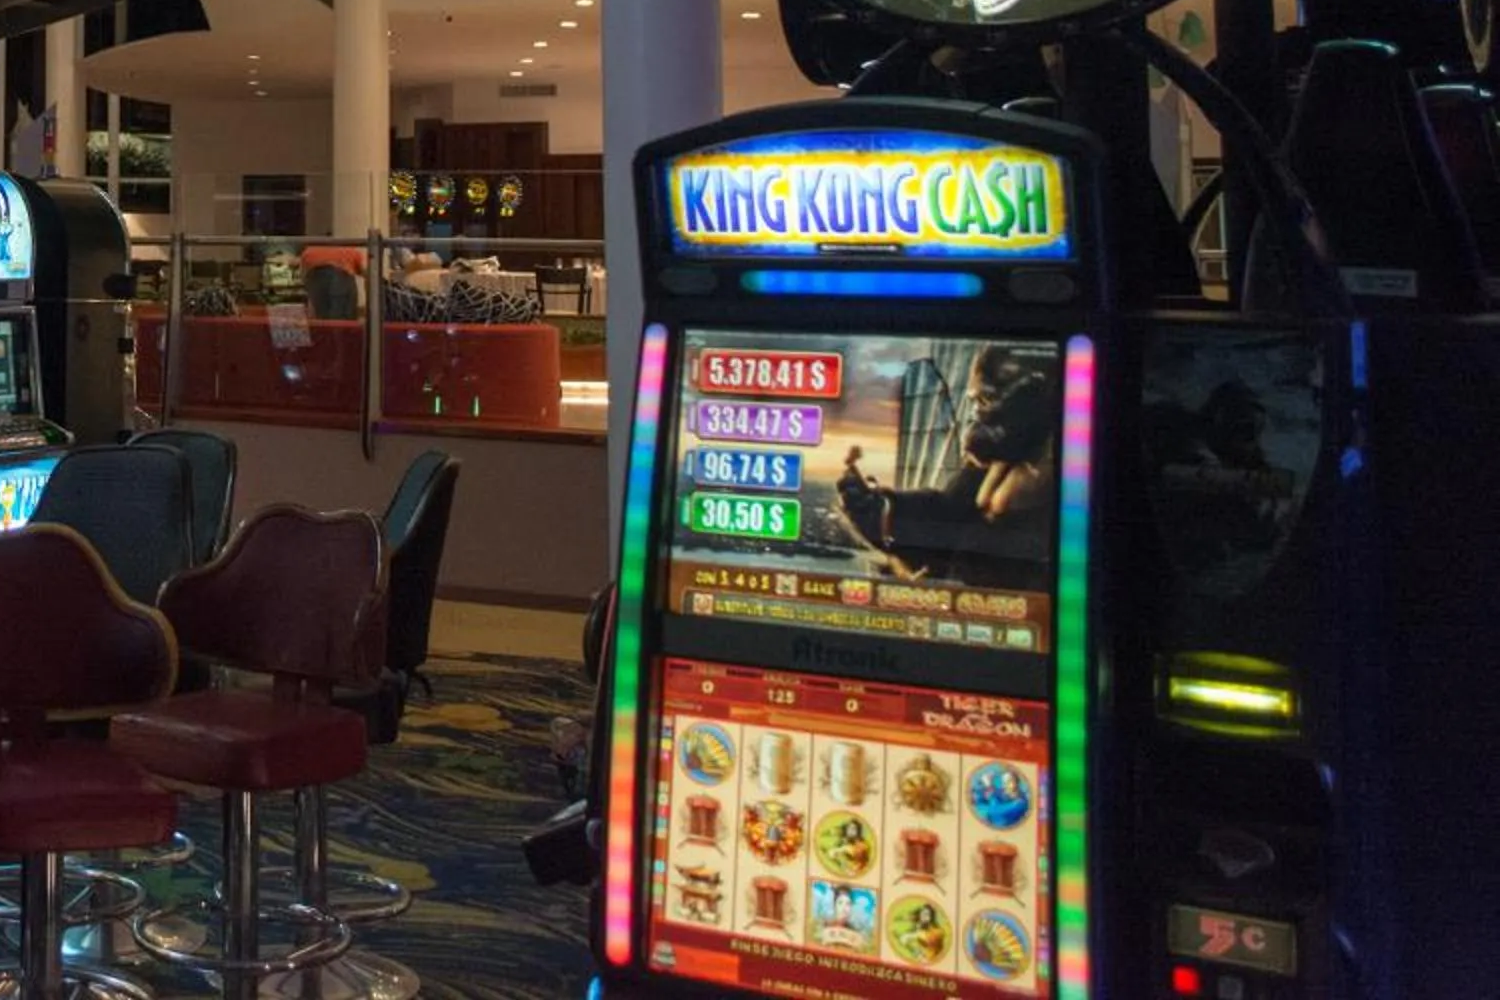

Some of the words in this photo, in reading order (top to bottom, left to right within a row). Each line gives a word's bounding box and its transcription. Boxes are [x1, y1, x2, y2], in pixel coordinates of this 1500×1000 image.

[681, 164, 787, 234] KING
[793, 163, 919, 235] KONG
[921, 710, 1032, 738] DRAGON
